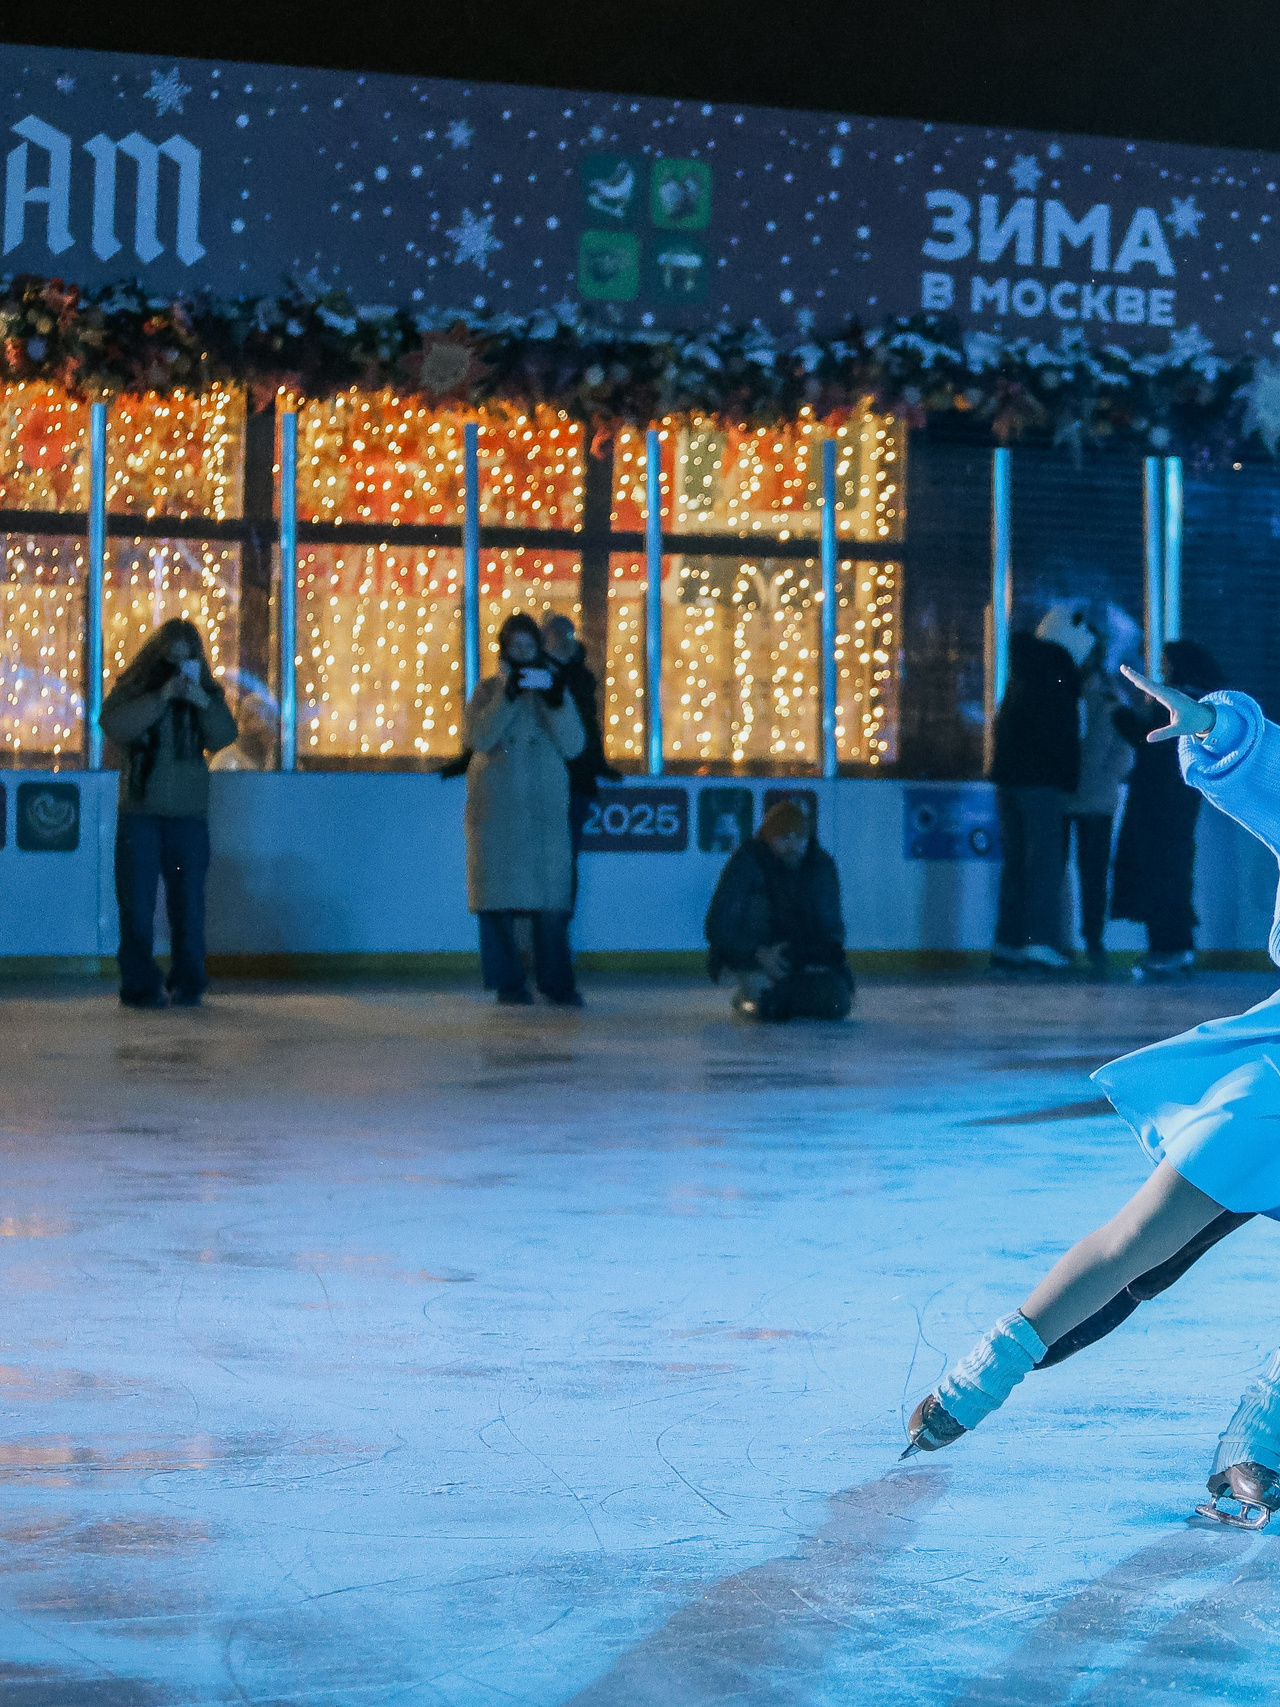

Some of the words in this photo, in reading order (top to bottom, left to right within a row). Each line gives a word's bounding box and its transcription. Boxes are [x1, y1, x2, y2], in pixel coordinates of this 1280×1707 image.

[921, 188, 1178, 278] ЗИМА
[921, 271, 954, 311] В
[970, 275, 1177, 328] МОСКВЕ
[582, 802, 681, 836] 2025
